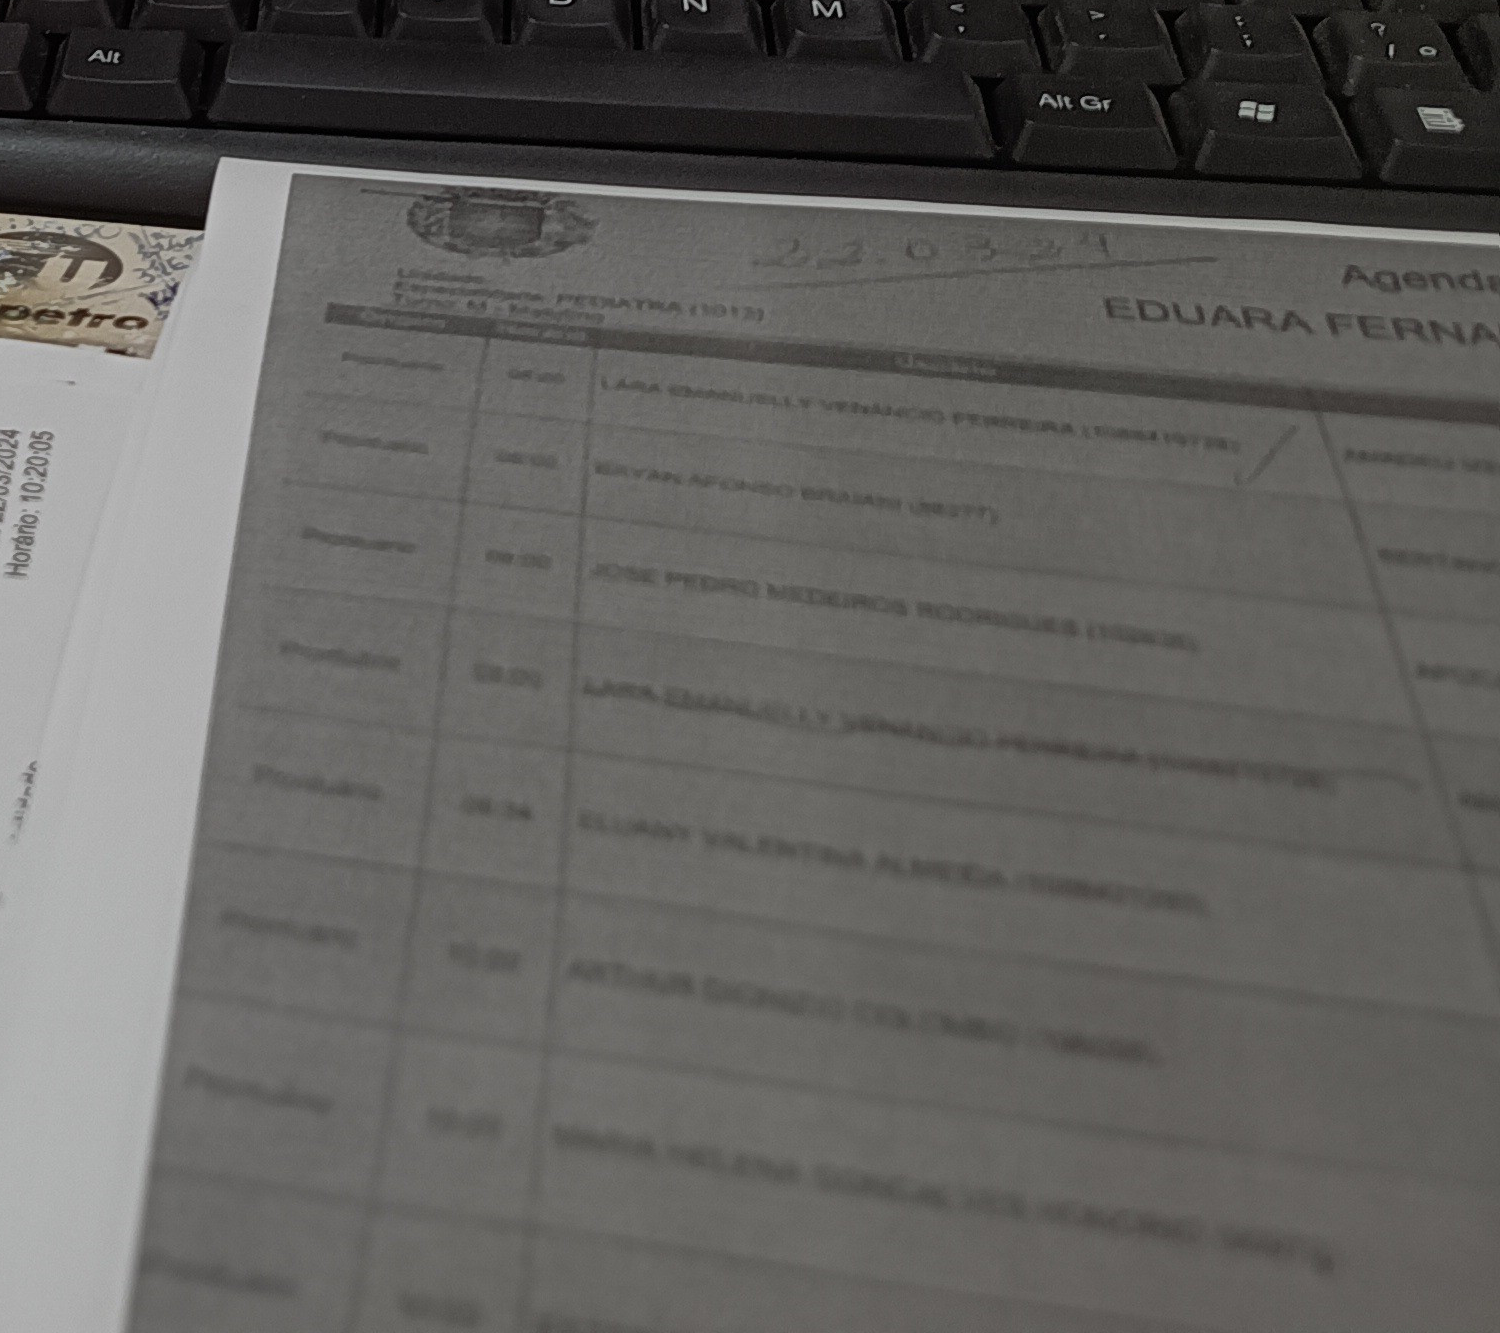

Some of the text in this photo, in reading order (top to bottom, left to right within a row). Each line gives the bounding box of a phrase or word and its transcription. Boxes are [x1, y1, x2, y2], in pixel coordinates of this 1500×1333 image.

[87, 48, 121, 65] Alt
[1038, 92, 1113, 112] Alt Gr
[1103, 295, 1315, 336] EDUARA
[20, 430, 55, 502] 10:20:05
